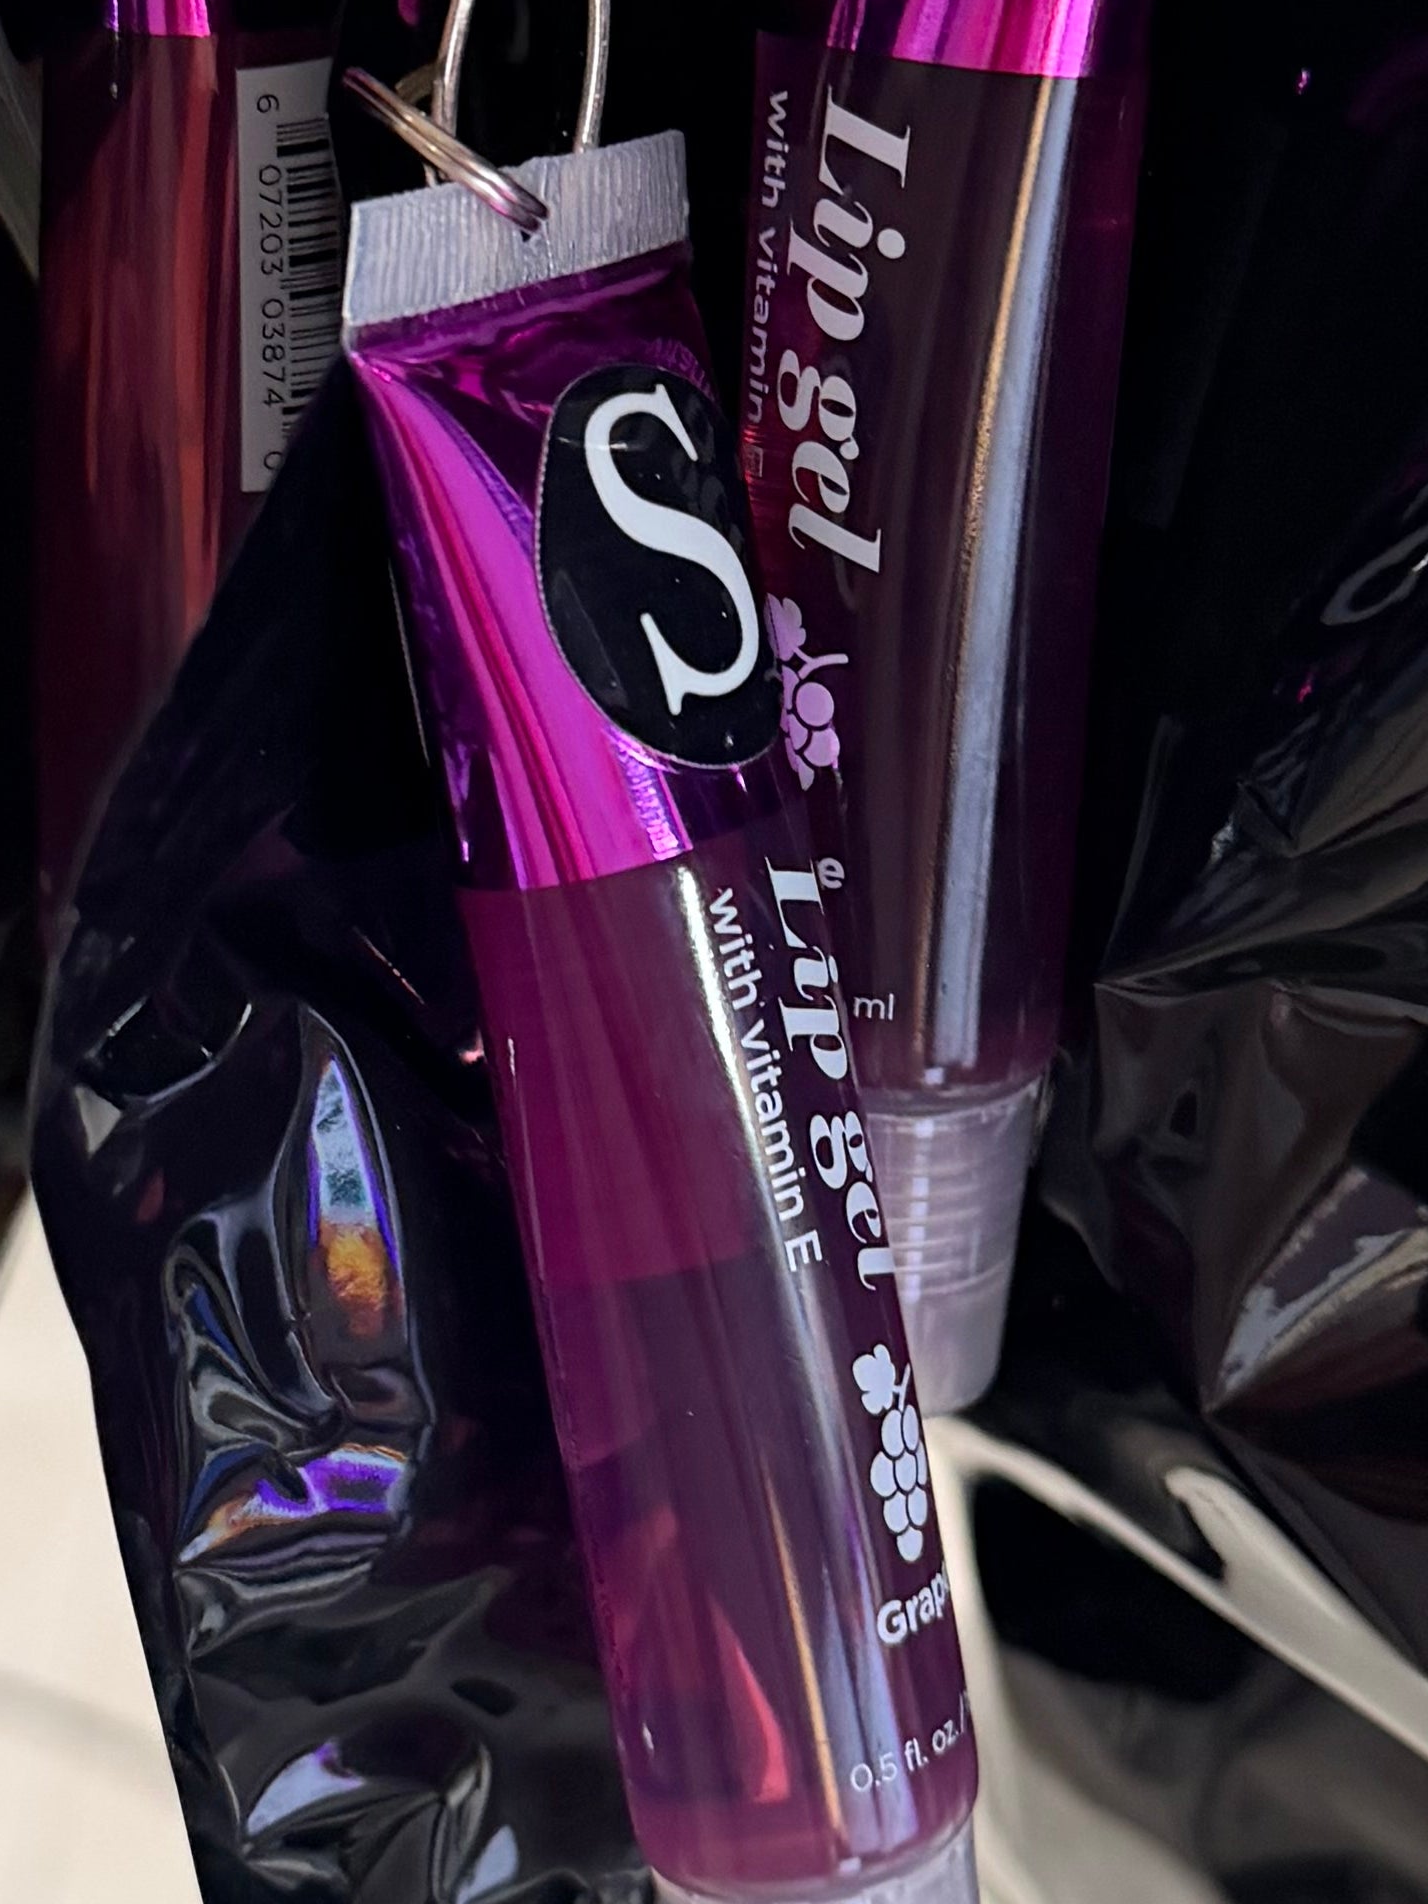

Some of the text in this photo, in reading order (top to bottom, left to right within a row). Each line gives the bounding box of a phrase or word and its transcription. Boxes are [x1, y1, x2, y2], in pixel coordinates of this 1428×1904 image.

[255, 93, 281, 115] 6
[760, 90, 789, 210] with
[257, 164, 284, 277] 07203
[260, 297, 287, 408] 03874
[745, 227, 779, 424] vitamin
[775, 84, 912, 575] Lip gel
[583, 383, 761, 716] S
[764, 855, 849, 1081] Lip
[708, 886, 824, 1273] with vitamin E
[849, 1752, 900, 1793] 0.5
[903, 1737, 930, 1772] fl.
